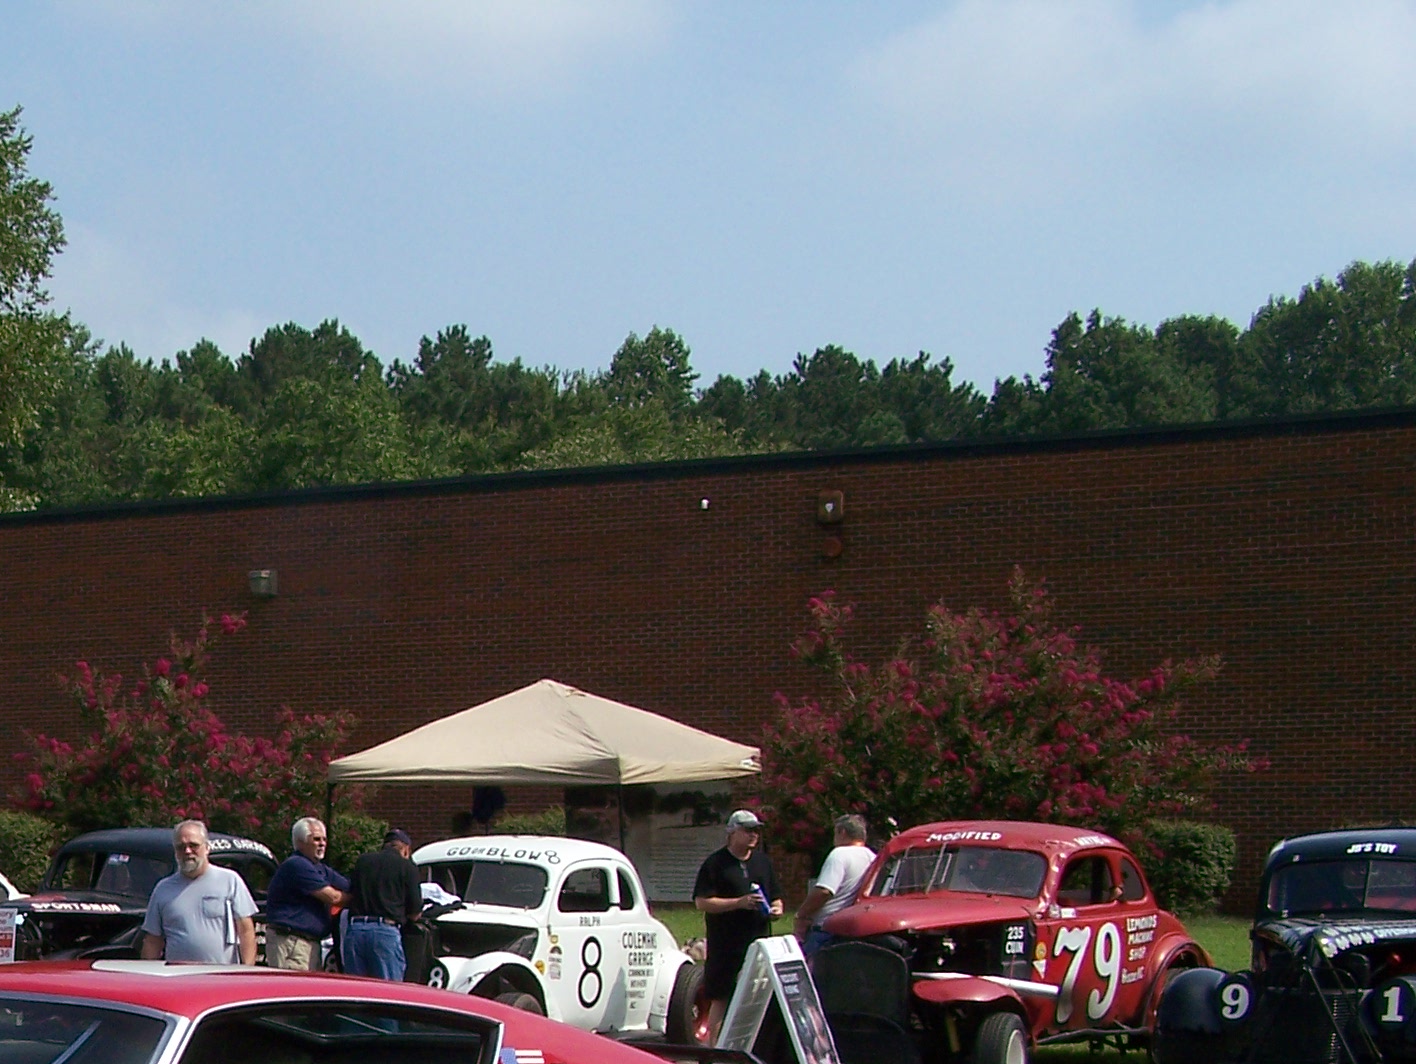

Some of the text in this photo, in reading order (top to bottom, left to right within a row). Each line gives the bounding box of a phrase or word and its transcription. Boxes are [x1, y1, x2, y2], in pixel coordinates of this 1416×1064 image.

[926, 831, 1002, 842] MODIFIED
[486, 847, 542, 860] BLOW
[30, 901, 121, 913] SPORTSMAN
[1007, 926, 1025, 940] 235
[428, 966, 444, 989] 8
[577, 935, 603, 1009] 8
[1052, 921, 1122, 1024] 79
[1220, 983, 1252, 1021] 9
[1381, 986, 1404, 1023] 1
